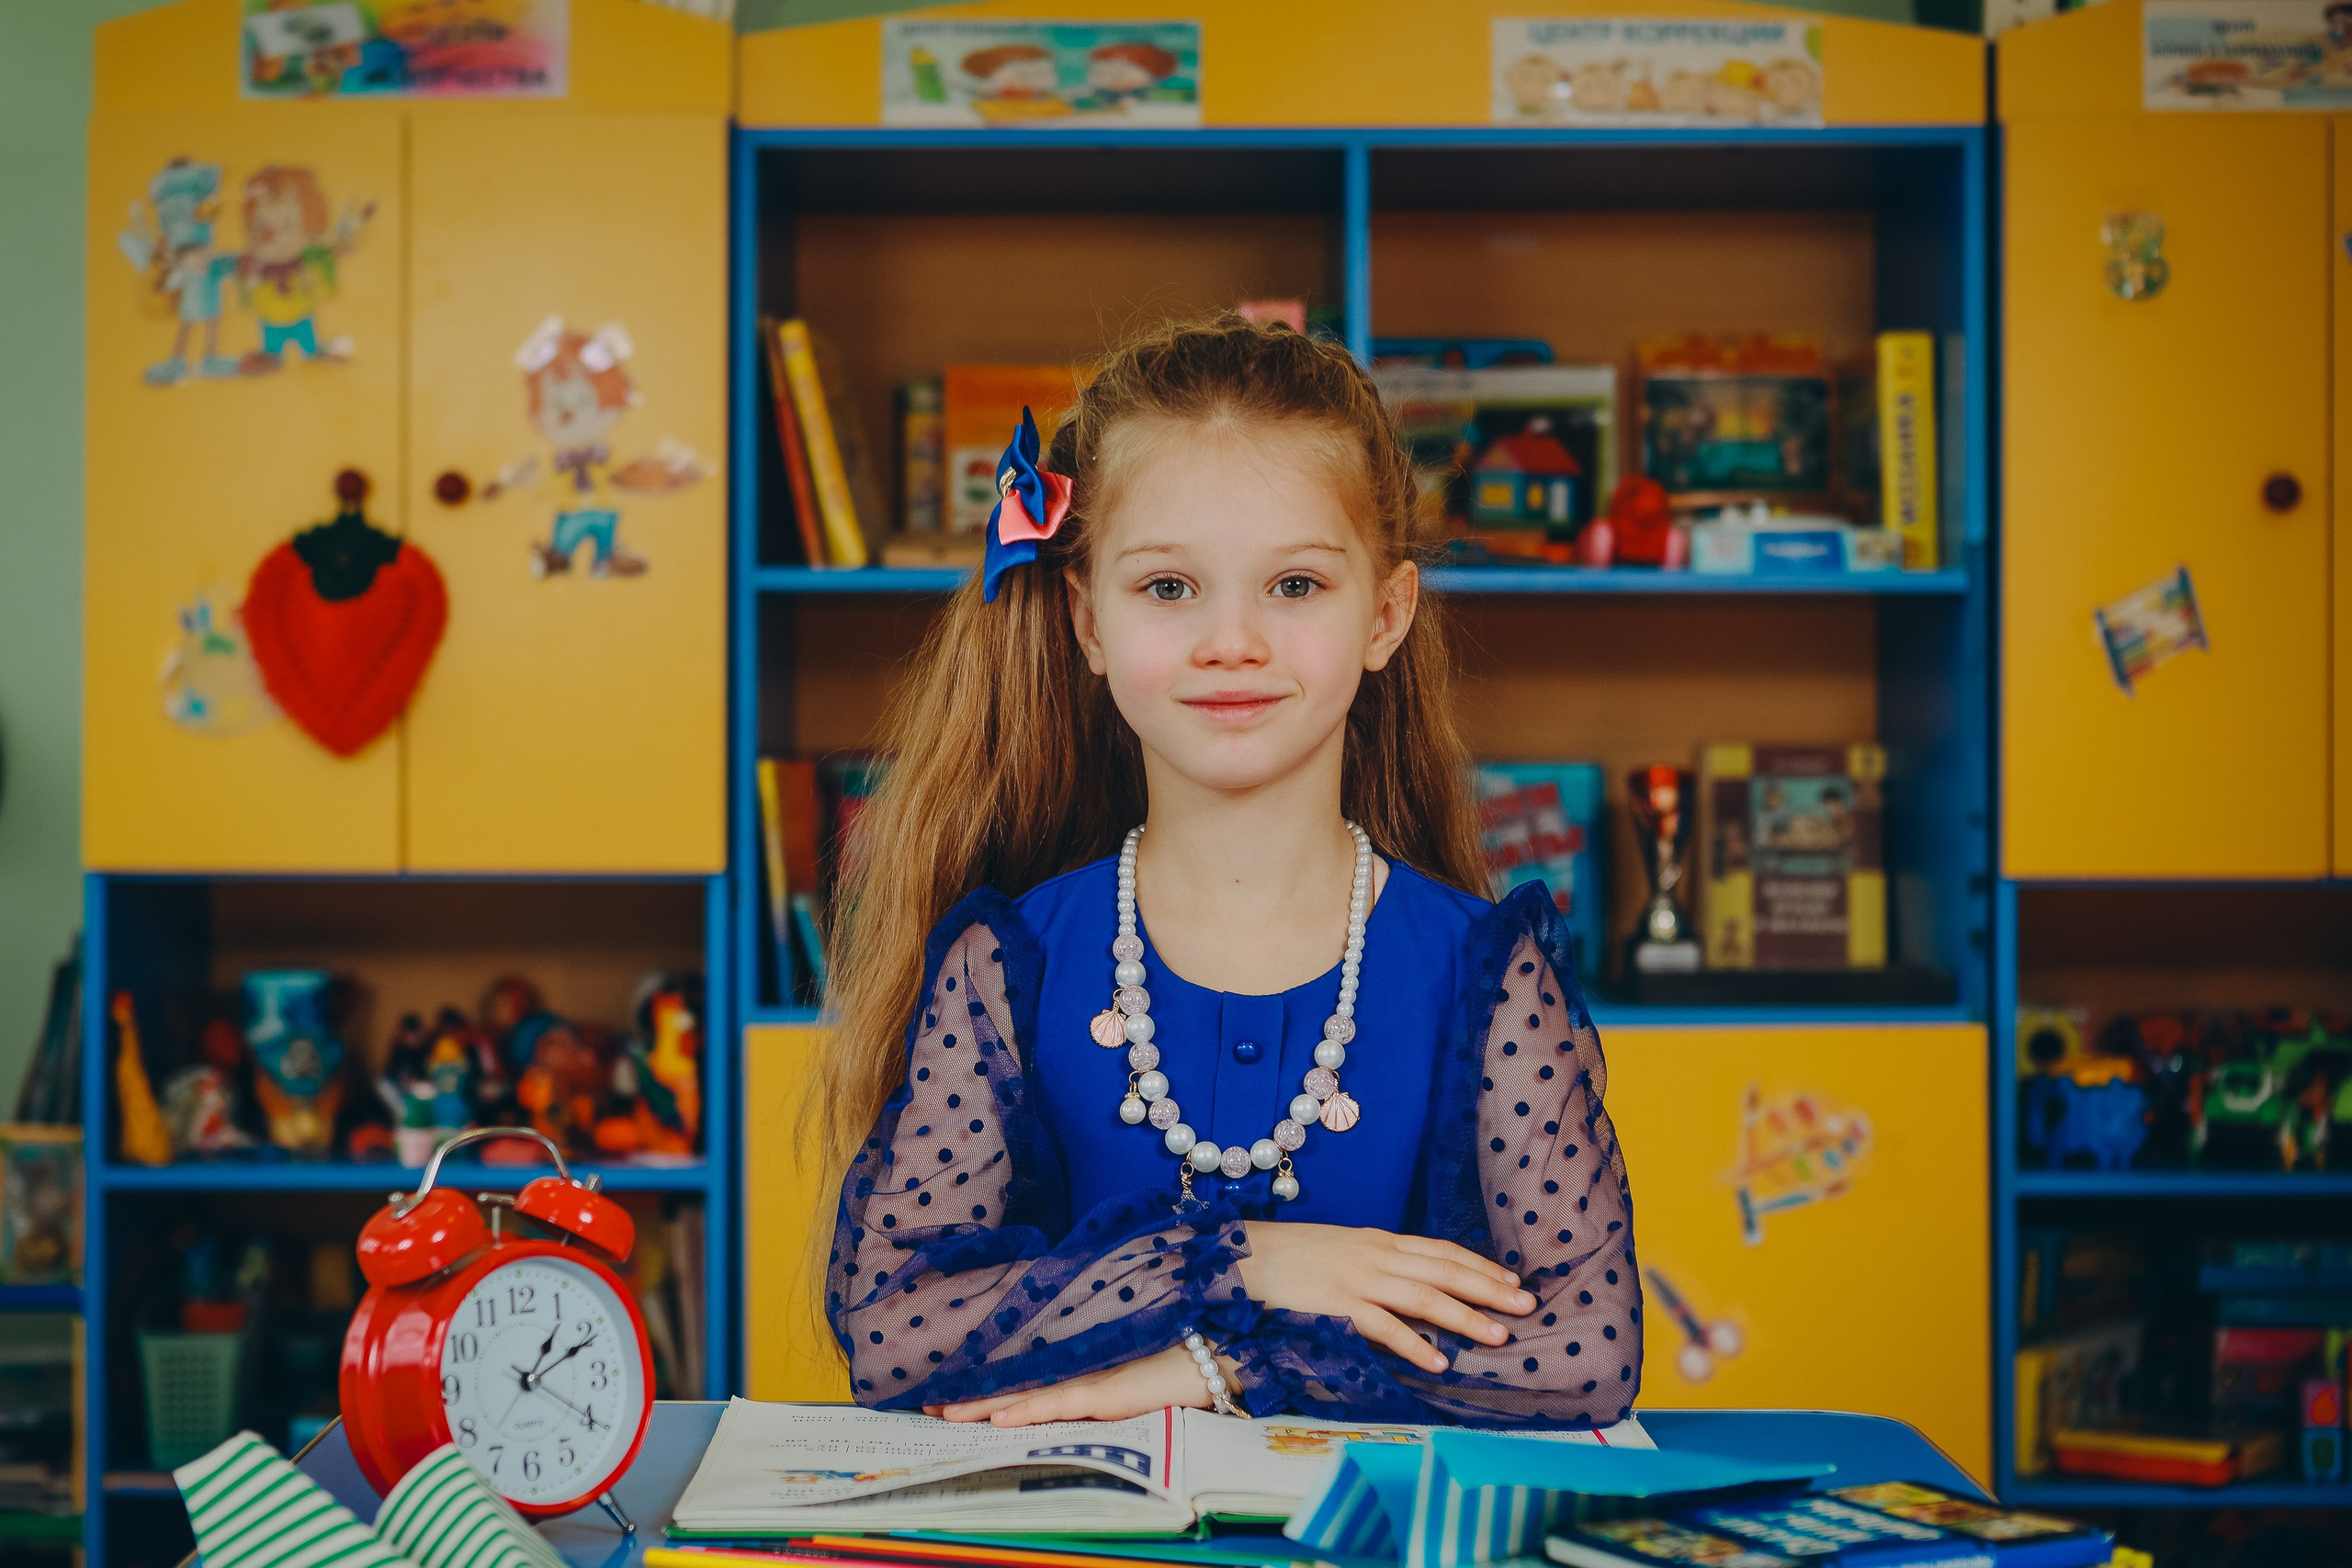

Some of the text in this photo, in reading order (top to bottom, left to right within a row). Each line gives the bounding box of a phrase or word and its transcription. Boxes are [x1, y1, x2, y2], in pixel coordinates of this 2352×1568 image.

[1526, 23, 1611, 44] ЦЕНТР
[475, 1298, 498, 1328] 11
[507, 1286, 537, 1315] 12
[553, 1292, 563, 1321] 1
[450, 1332, 478, 1364] 10
[576, 1321, 594, 1348] 2
[441, 1374, 460, 1406] 9
[591, 1360, 607, 1392] 3
[458, 1417, 477, 1449] 8
[580, 1404, 596, 1433] 4
[488, 1444, 504, 1474] 7
[523, 1450, 540, 1482] 6
[559, 1437, 575, 1468] 5
